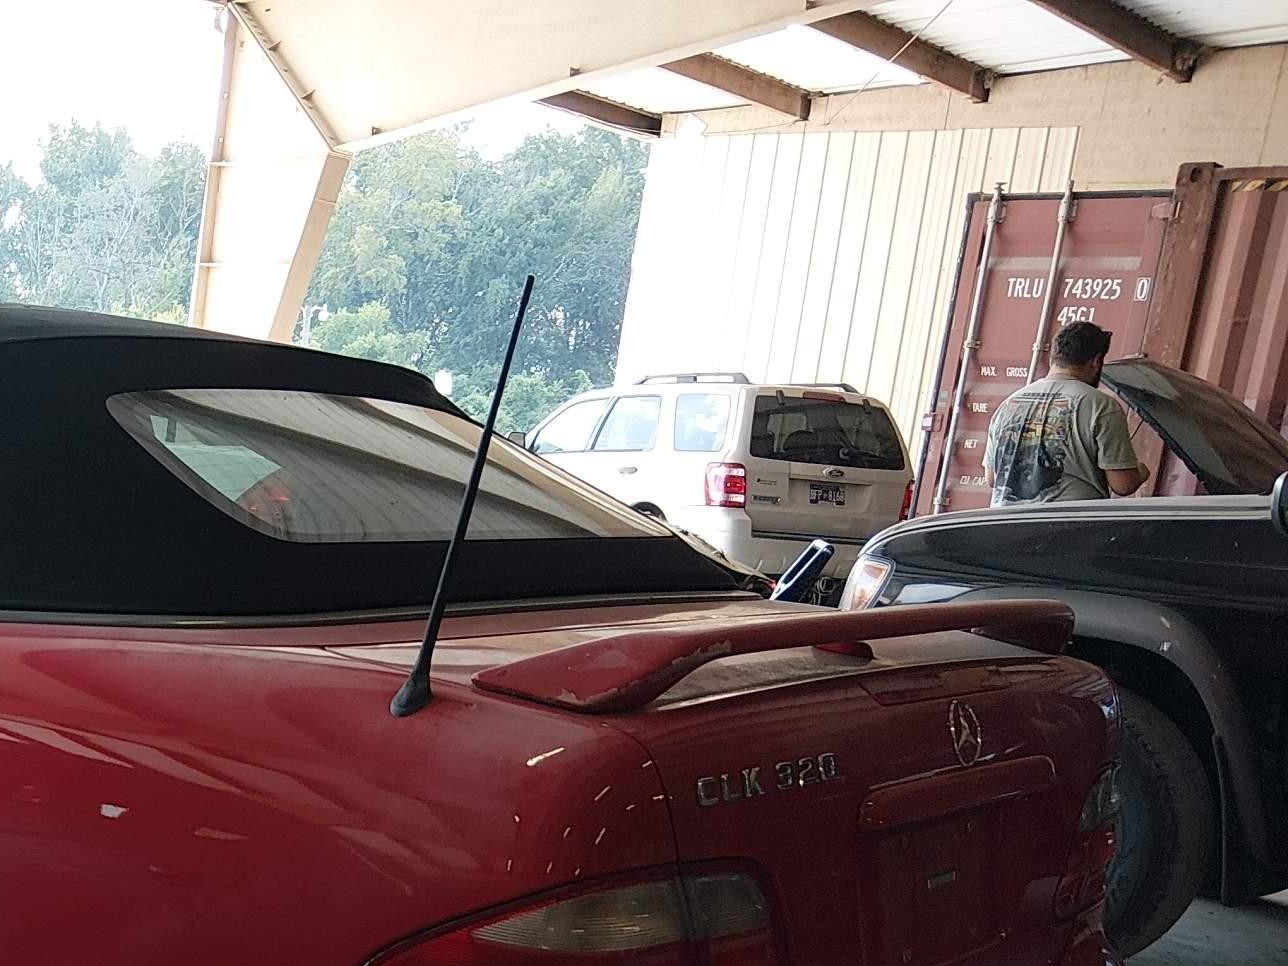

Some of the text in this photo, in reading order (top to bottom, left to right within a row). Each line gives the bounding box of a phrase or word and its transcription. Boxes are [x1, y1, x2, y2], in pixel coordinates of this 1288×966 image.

[1007, 277, 1149, 300] TRLU 743925 0
[1057, 306, 1095, 326] 45G1
[1006, 366, 1028, 378] GROSS
[971, 402, 988, 414] TARE
[964, 438, 979, 450] NET
[696, 752, 837, 806] CLK 320
